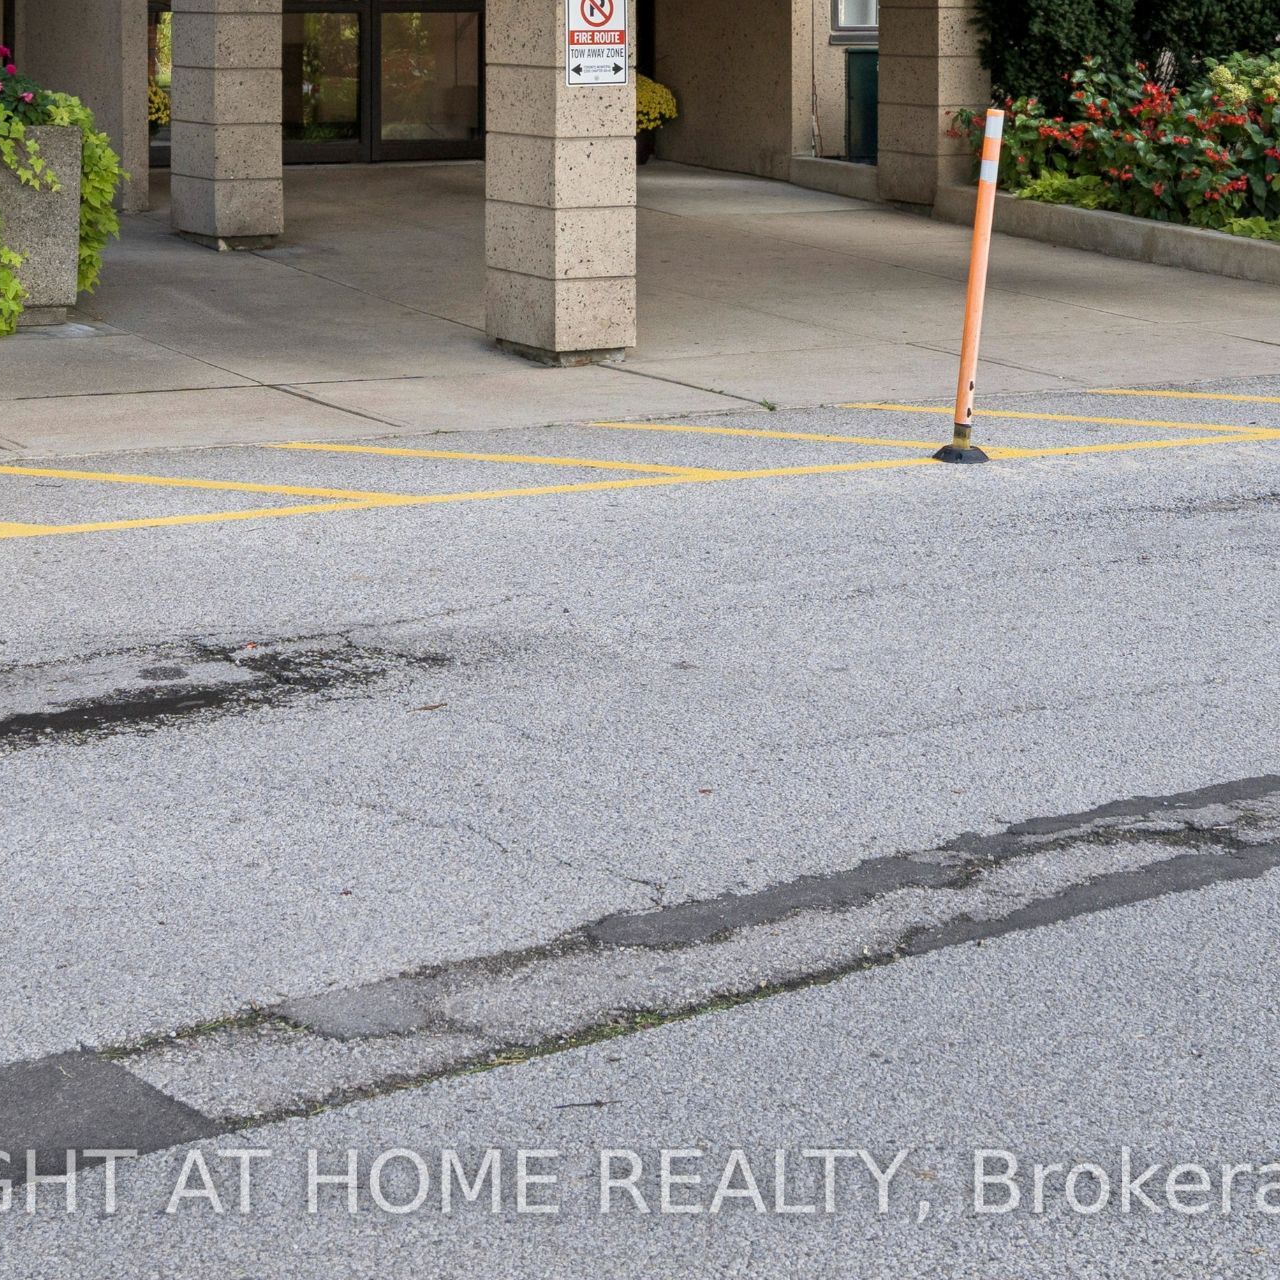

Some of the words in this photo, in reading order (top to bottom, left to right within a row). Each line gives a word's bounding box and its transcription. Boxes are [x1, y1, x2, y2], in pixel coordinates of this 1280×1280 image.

[574, 31, 593, 44] FIRE
[594, 31, 621, 44] ROUTE
[571, 48, 586, 59] TOW
[587, 48, 605, 59] AWAY
[606, 47, 625, 59] ZONE
